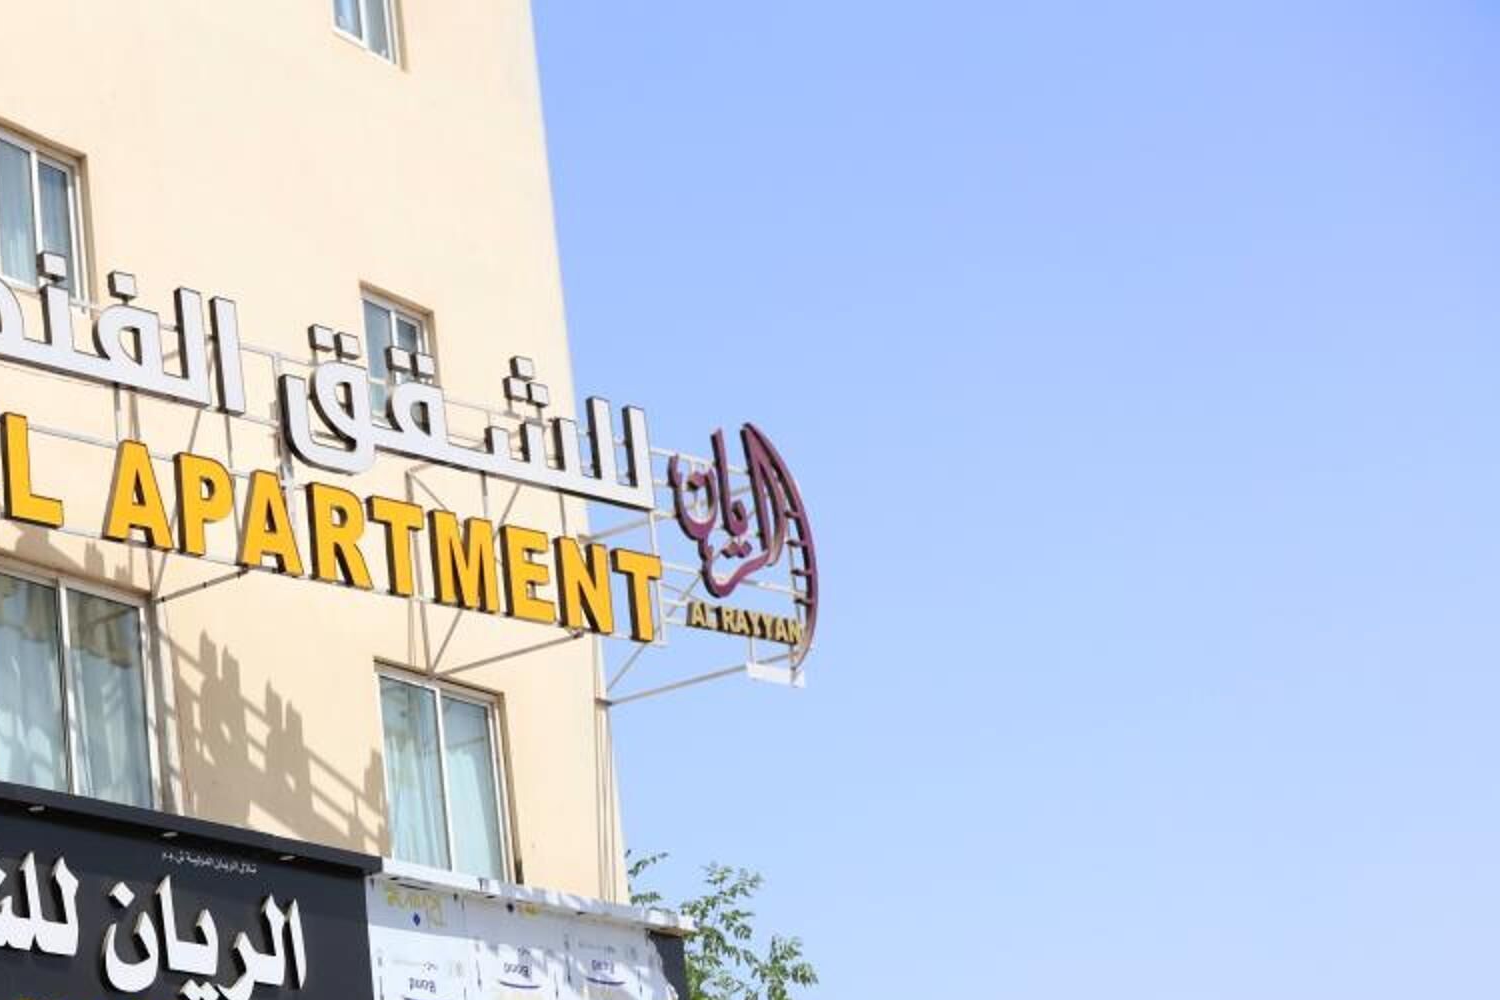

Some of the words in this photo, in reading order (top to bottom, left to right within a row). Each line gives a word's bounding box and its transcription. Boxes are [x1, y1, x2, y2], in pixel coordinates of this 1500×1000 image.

[277, 324, 654, 509] للشقق
[102, 439, 662, 642] APARTMENT
[689, 602, 717, 630] AL
[722, 607, 803, 643] RAYYAN
